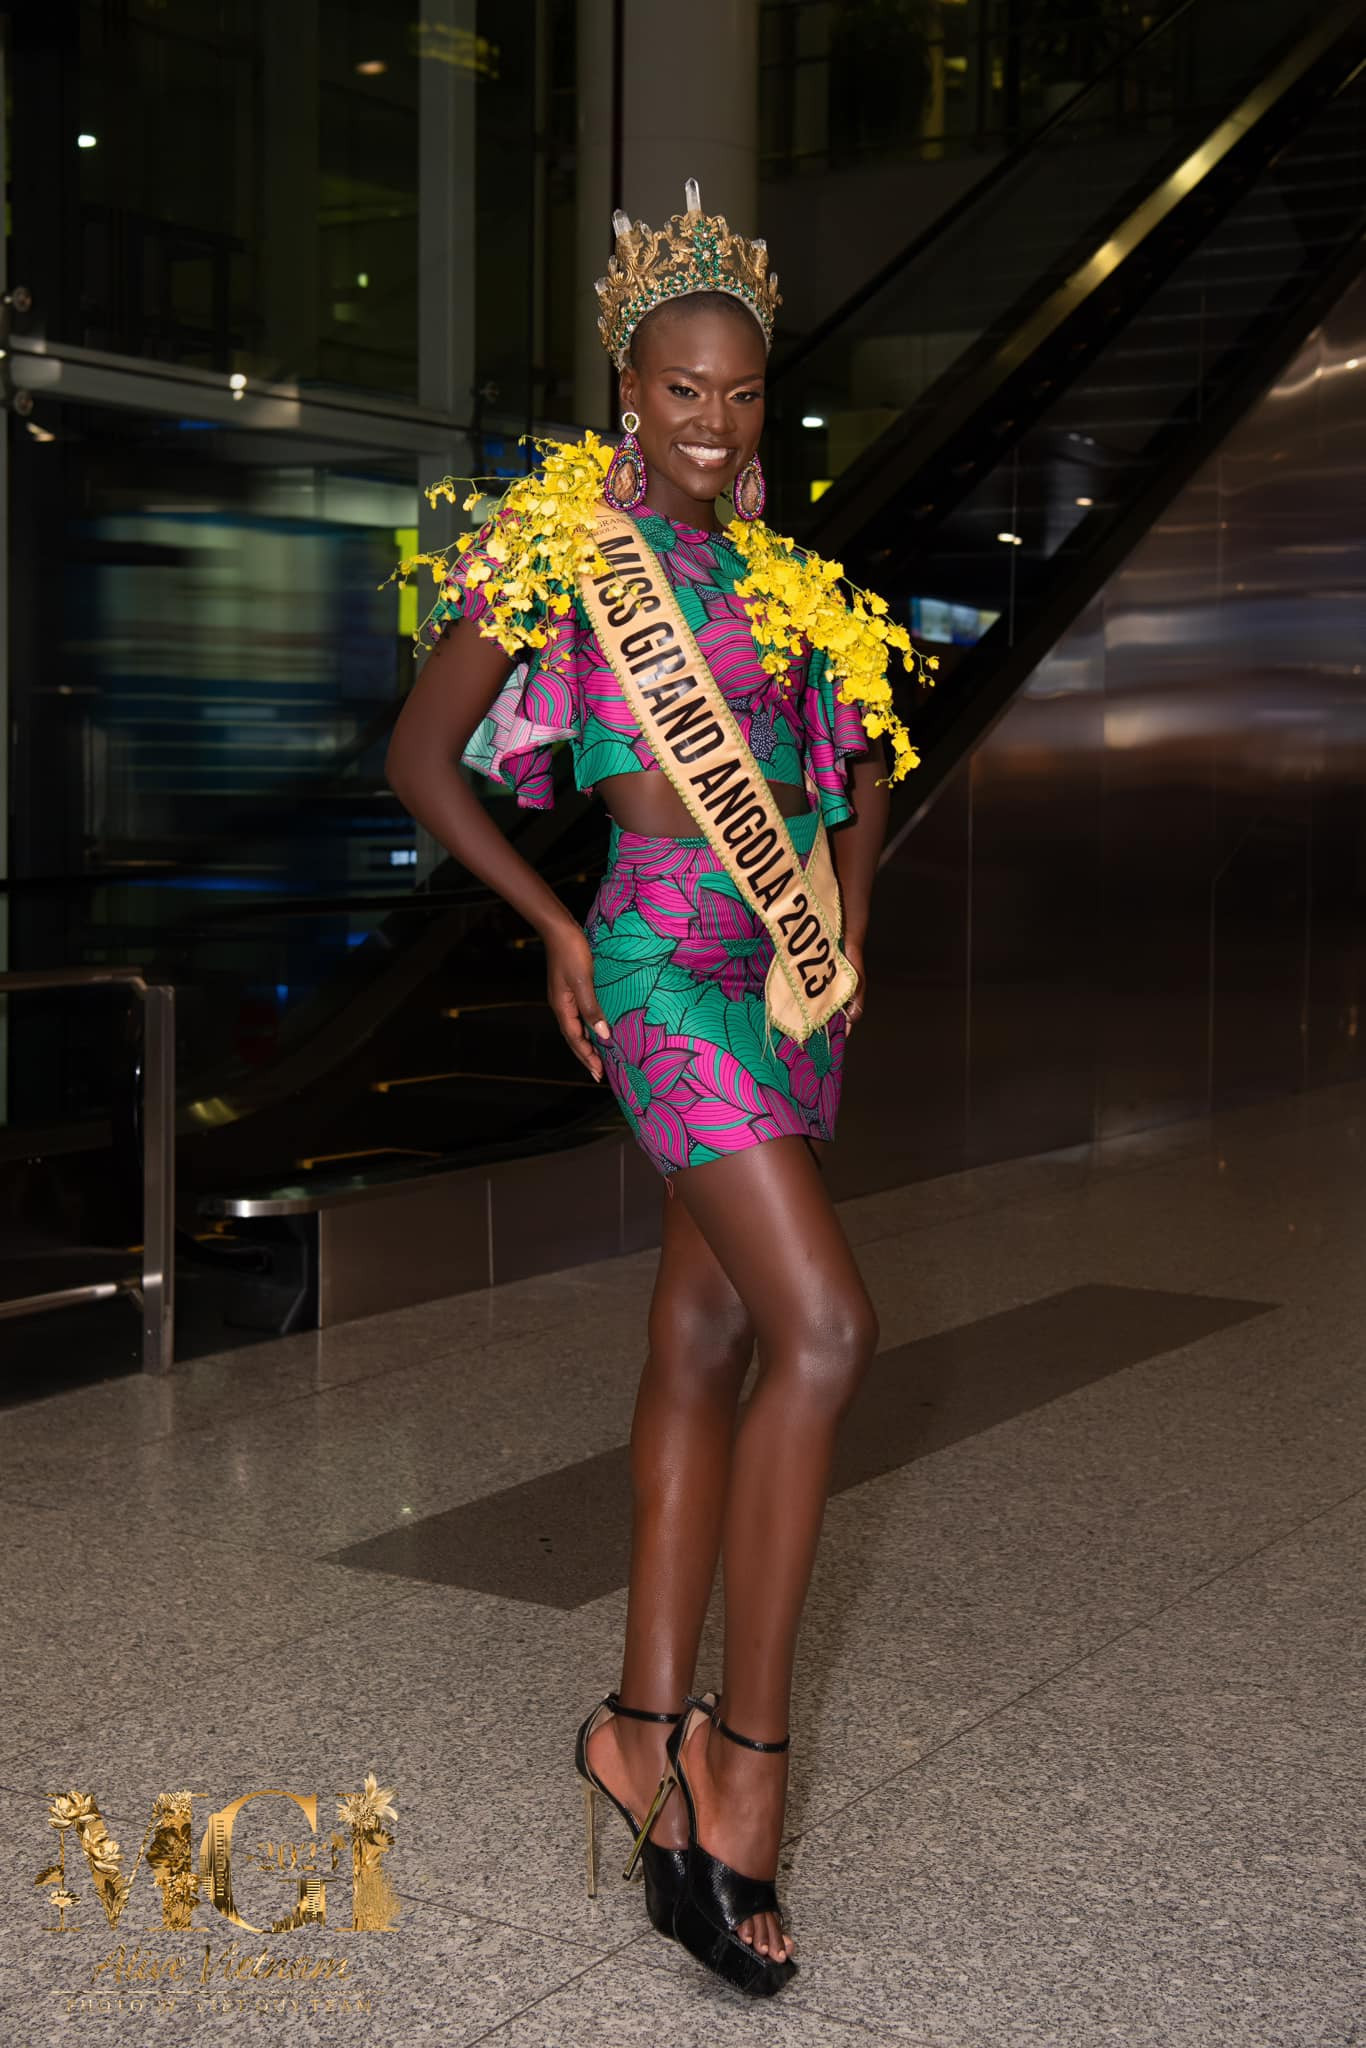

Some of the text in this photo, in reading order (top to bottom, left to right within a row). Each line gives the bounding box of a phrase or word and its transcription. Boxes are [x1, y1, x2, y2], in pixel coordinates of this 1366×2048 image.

[592, 535, 837, 999] MISS GRAND ANGOLA 2023
